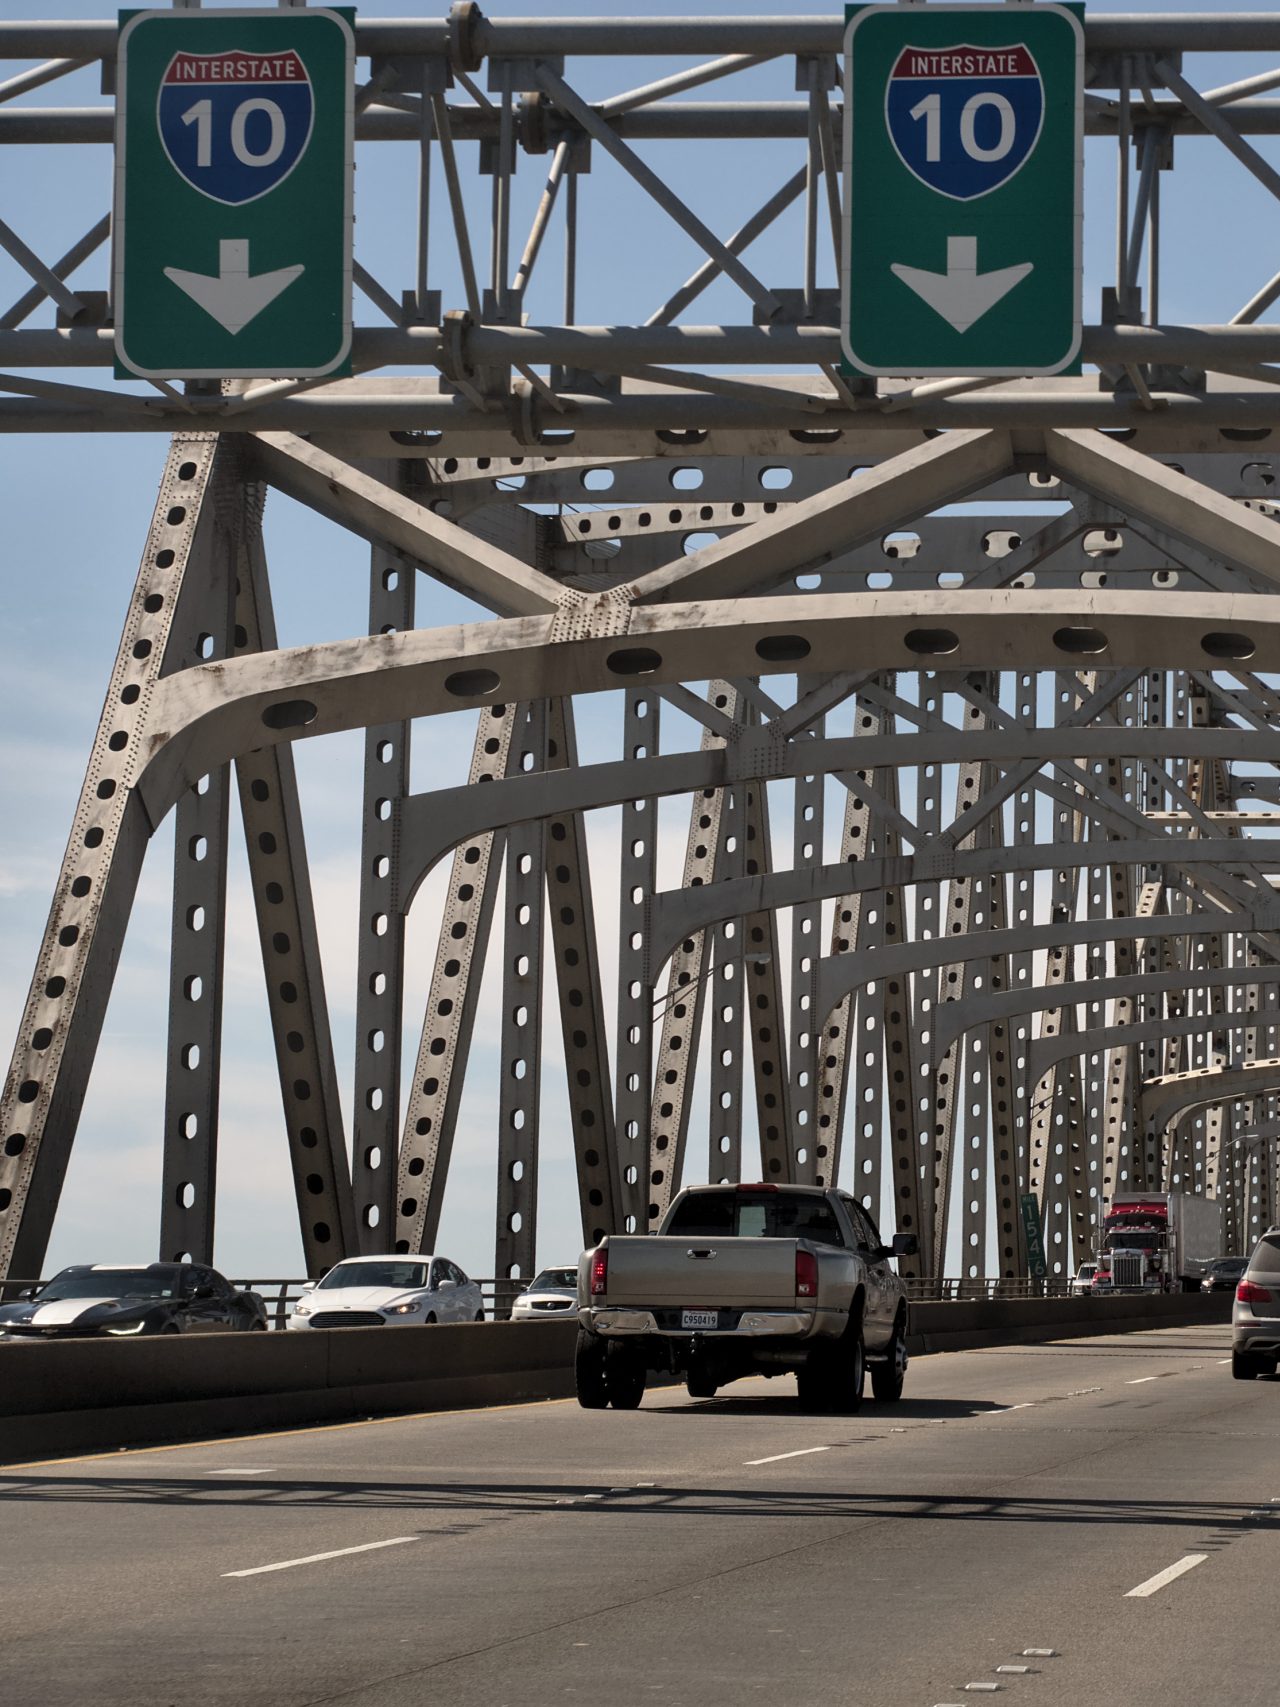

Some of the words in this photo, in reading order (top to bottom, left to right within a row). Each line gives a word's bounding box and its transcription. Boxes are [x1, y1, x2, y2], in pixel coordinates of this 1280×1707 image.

[175, 60, 296, 80] INTERSTATE
[910, 54, 1019, 76] INTERSTATE
[180, 97, 287, 168] 10
[909, 92, 1016, 163] 10
[684, 1315, 716, 1325] C950419
